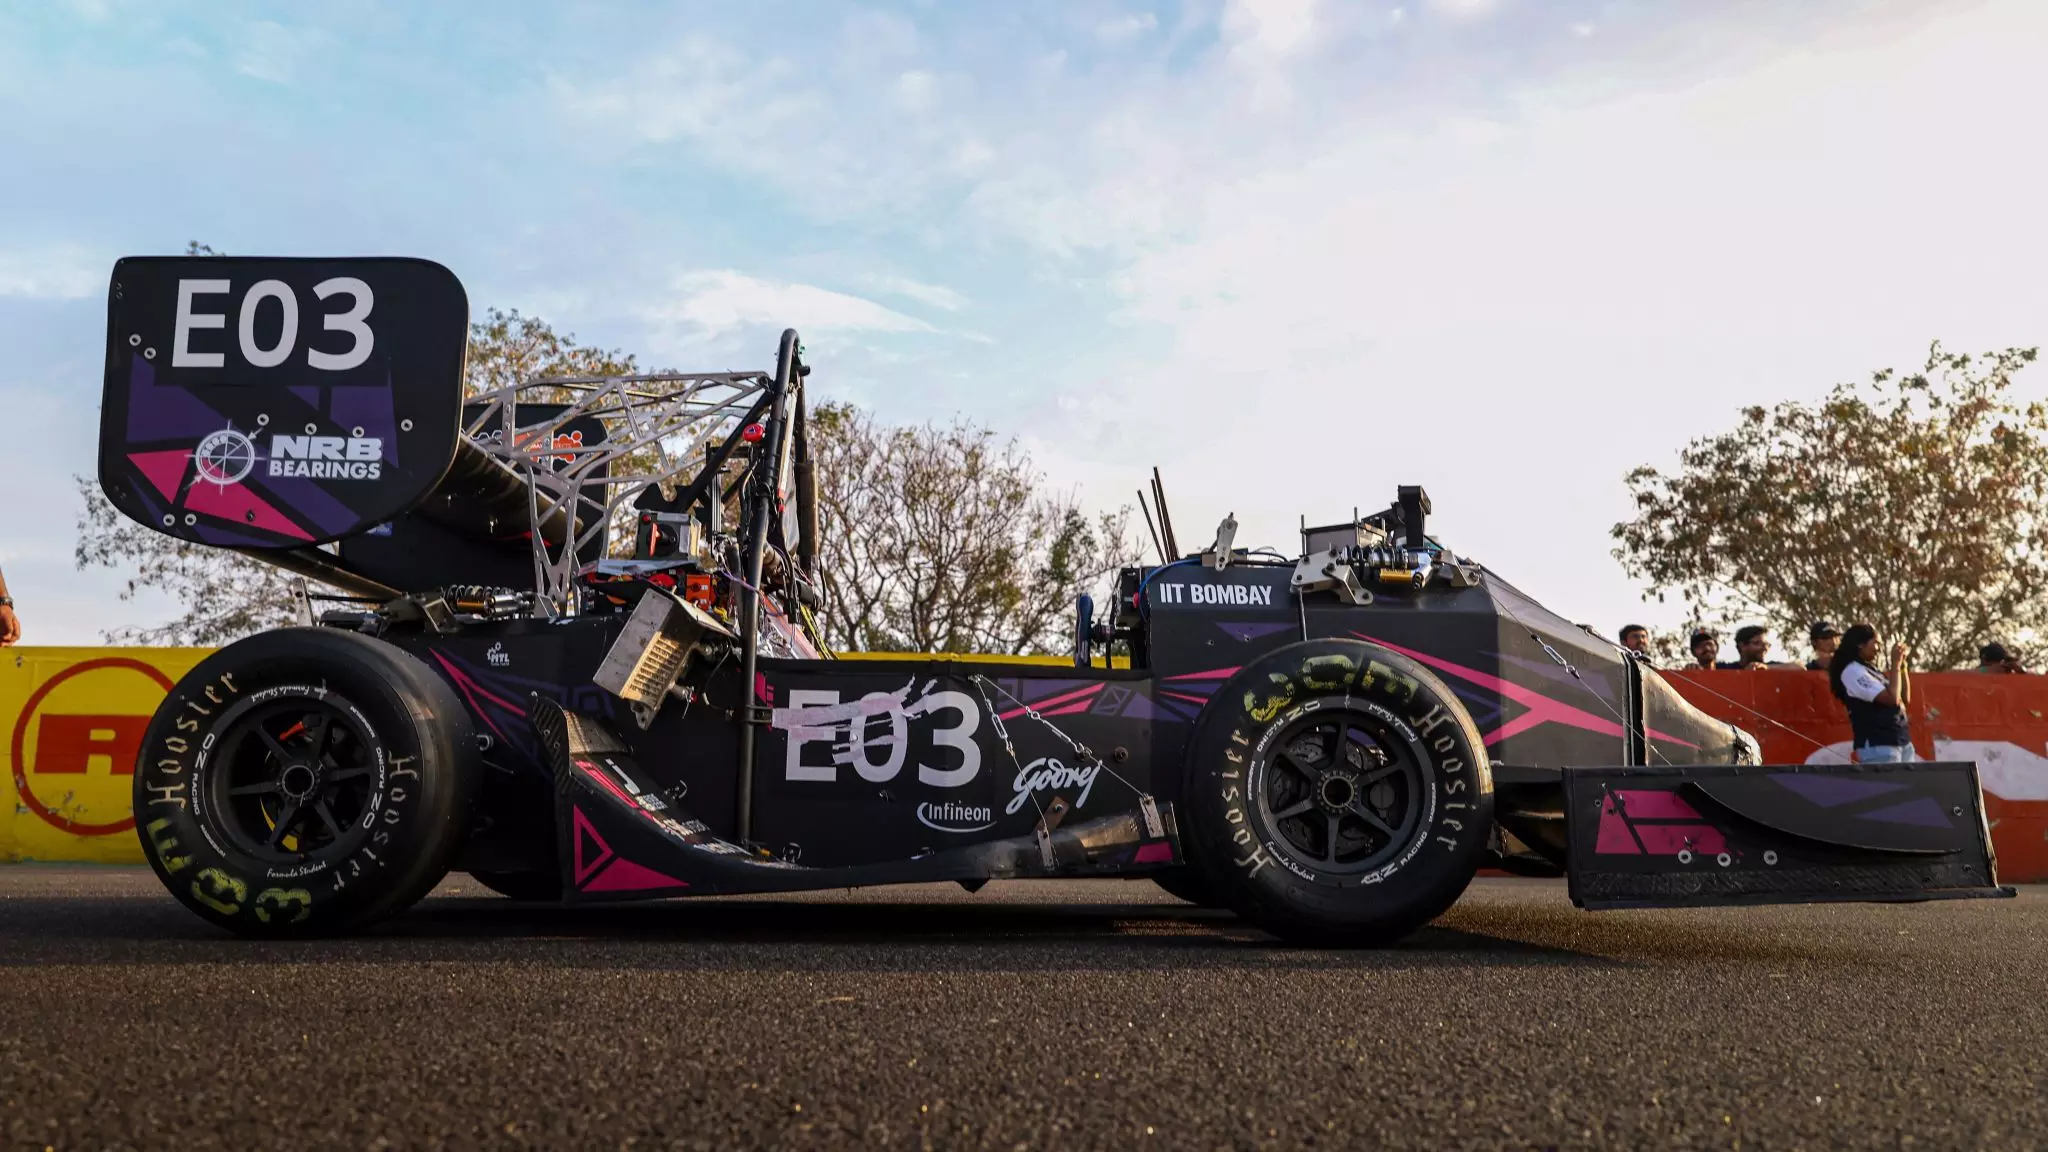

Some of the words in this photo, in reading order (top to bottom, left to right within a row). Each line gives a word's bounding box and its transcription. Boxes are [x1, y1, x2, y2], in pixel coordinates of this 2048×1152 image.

[171, 277, 375, 371] E03
[269, 460, 380, 479] BEARINGS
[271, 435, 382, 460] NRB
[1160, 583, 1184, 603] IIT
[1189, 583, 1272, 605] BOMBAY
[147, 671, 238, 813] Hoosier
[785, 690, 982, 787] E03
[375, 746, 385, 789] RACING
[1005, 757, 1103, 815] Godrej
[1409, 703, 1477, 852] Hoosier
[192, 772, 201, 816] RACING
[928, 800, 991, 822] Infineon
[1221, 728, 1276, 880] Hoosier
